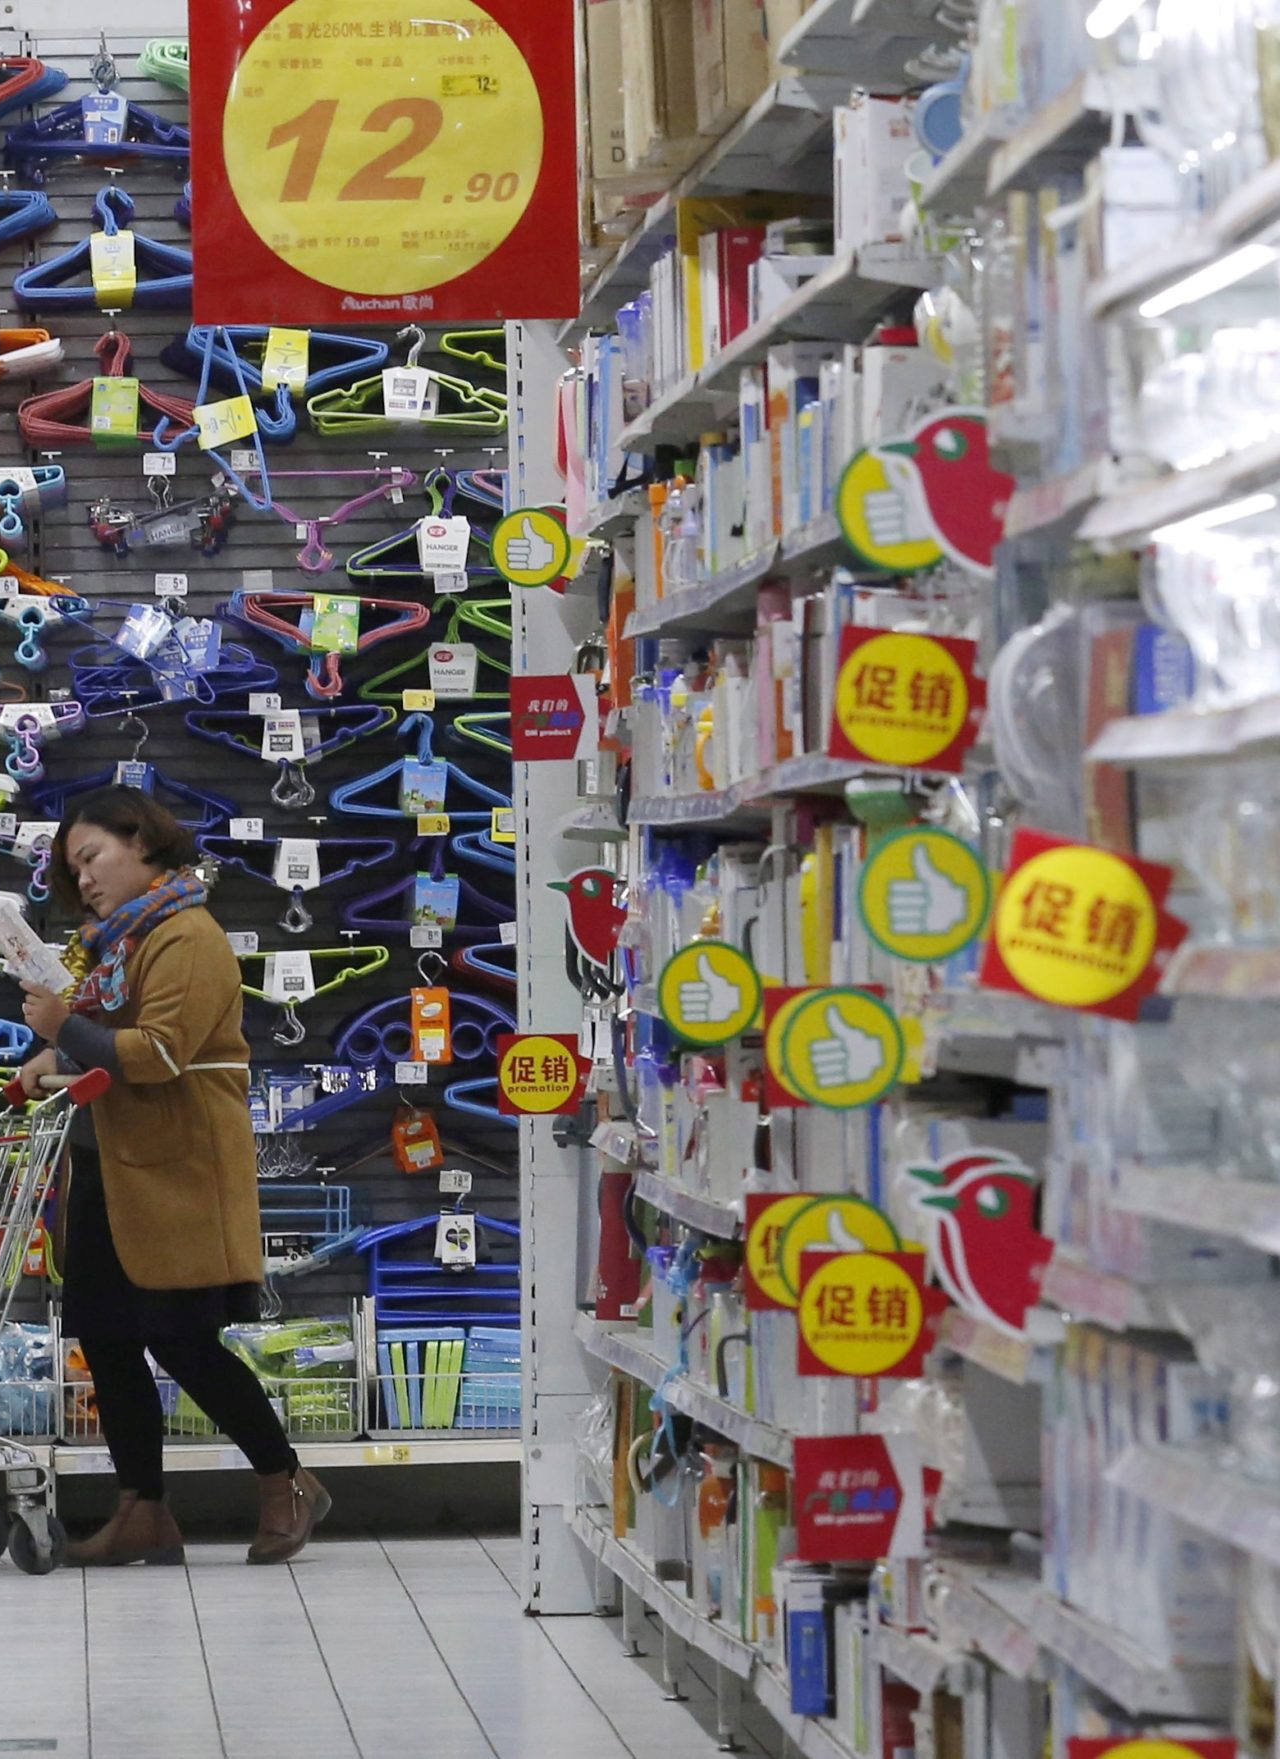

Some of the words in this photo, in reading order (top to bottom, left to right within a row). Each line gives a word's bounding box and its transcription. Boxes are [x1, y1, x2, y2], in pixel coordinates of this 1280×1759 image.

[341, 296, 400, 311] Auchan
[426, 543, 459, 551] HANGER
[434, 668, 466, 676] HANGER
[850, 663, 955, 719] 促销
[1018, 879, 1144, 956] 促销
[508, 1055, 569, 1084] 促销
[507, 1083, 570, 1095] promotion
[815, 1284, 909, 1329] 促销
